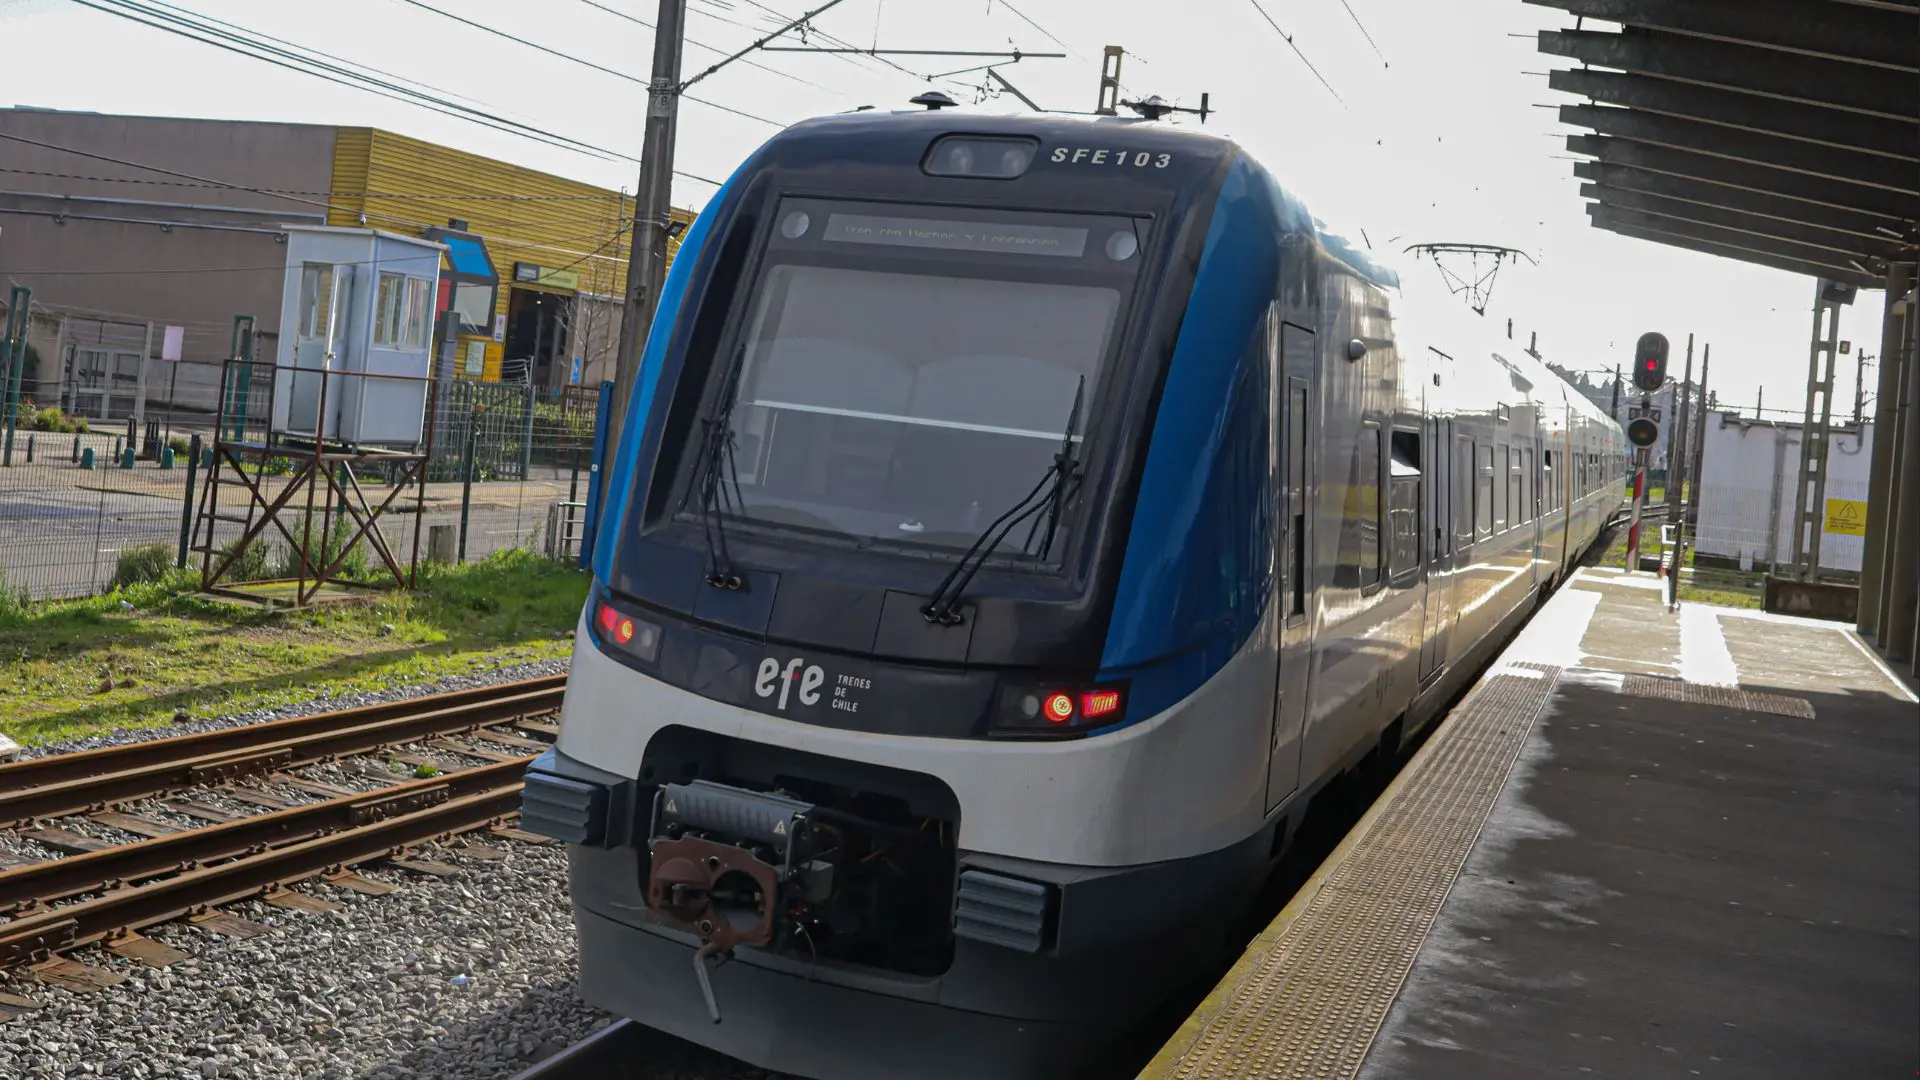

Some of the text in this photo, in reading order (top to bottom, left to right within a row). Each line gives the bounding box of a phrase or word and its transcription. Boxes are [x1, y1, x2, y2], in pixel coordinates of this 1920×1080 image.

[1050, 147, 1171, 169] SFE103
[754, 657, 825, 710] efe
[838, 674, 871, 689] TRENES
[834, 687, 847, 697] DE
[832, 699, 858, 712] CHILE
